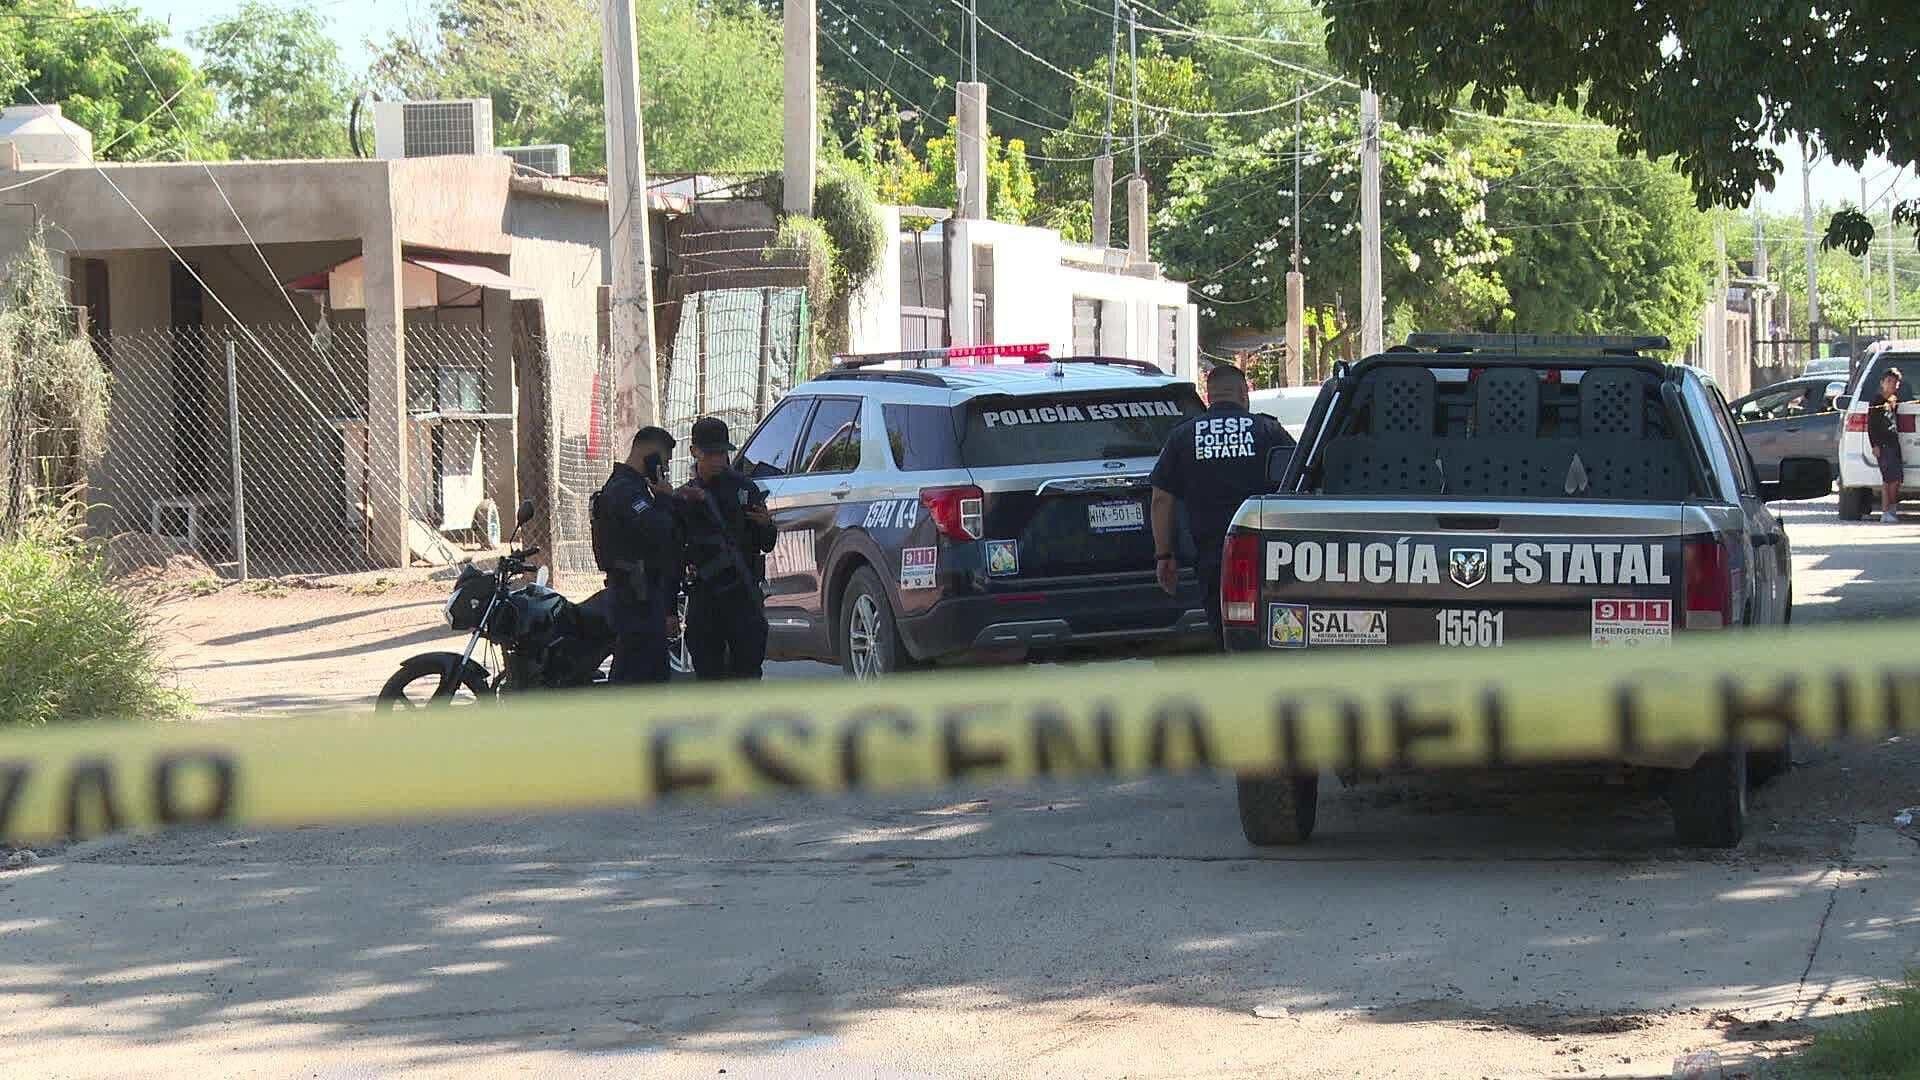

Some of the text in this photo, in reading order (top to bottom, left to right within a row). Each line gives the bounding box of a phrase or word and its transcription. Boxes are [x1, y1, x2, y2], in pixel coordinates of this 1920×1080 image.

[982, 401, 1184, 428] POLICÍA ESTATAL
[1195, 417, 1254, 435] PESP
[1195, 443, 1256, 460] ESTATAL
[862, 499, 919, 529] 15747 K-9
[1266, 537, 1671, 584] POLICÍA ESTATAL
[1600, 604, 1663, 619] 911
[1435, 608, 1504, 648] 15561
[1594, 627, 1670, 636] EMERGENCIAS
